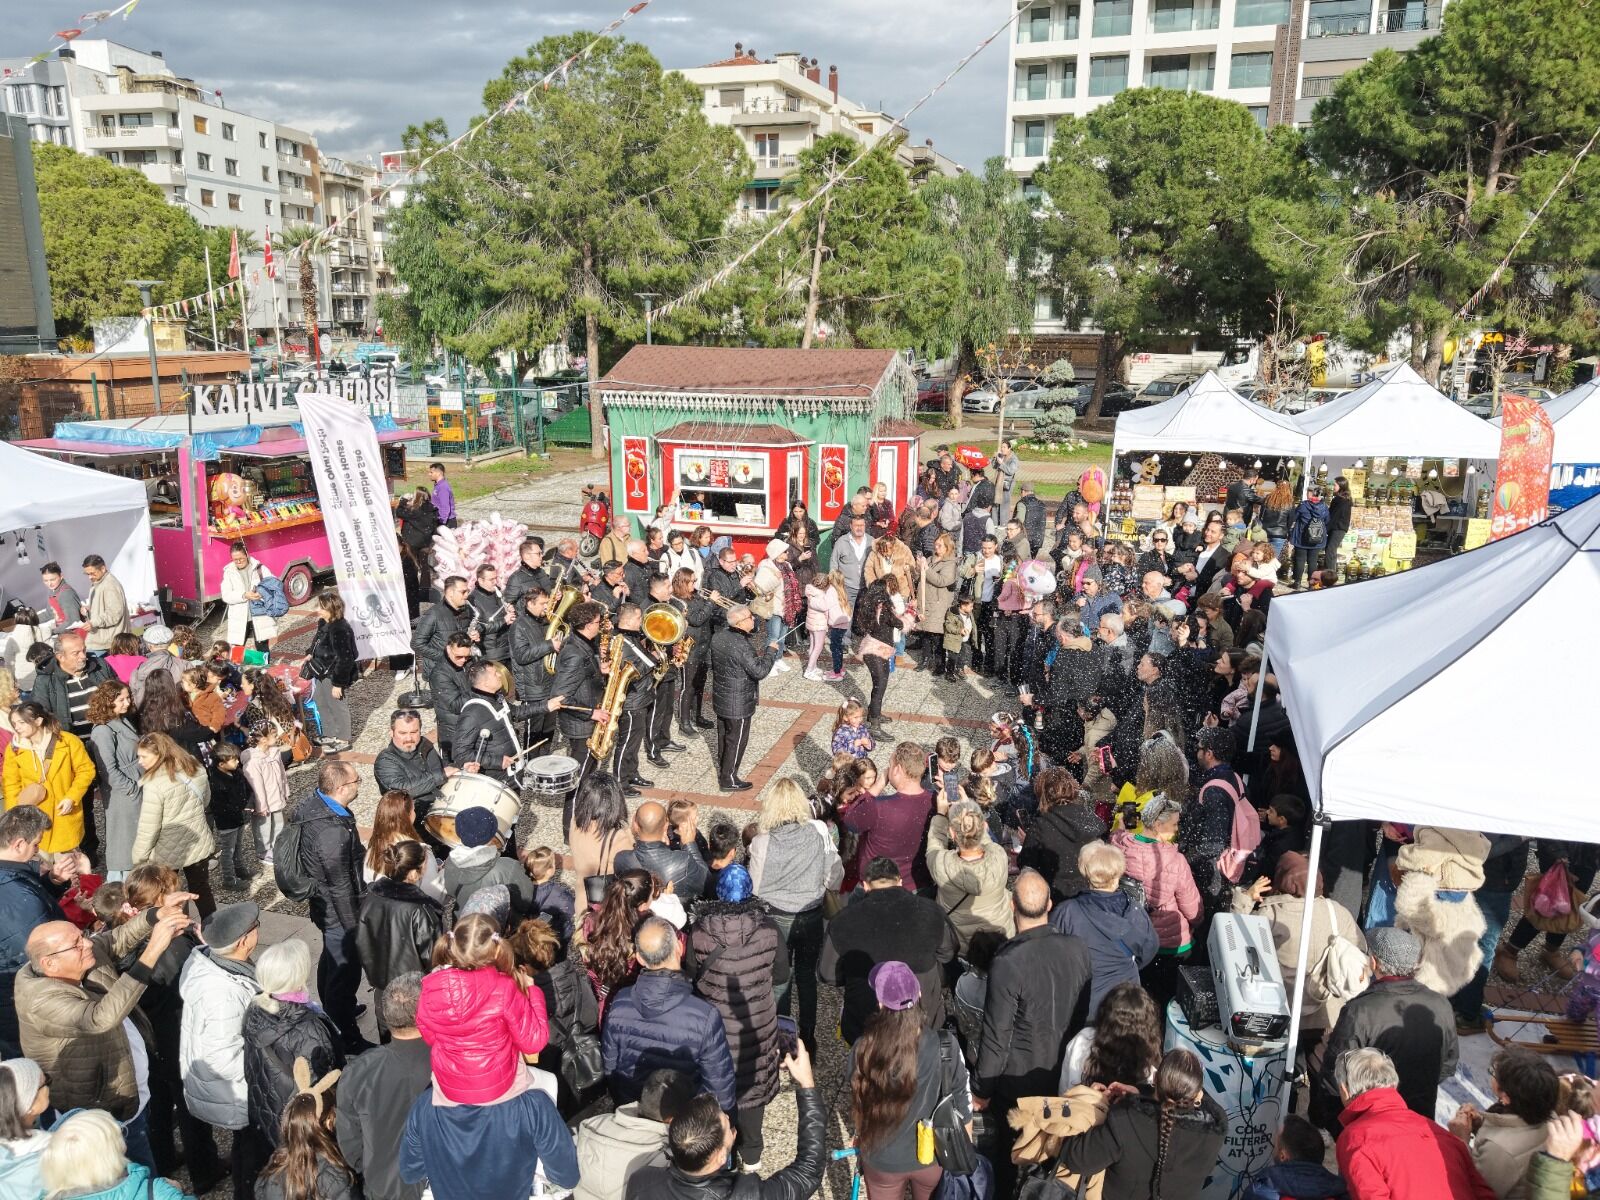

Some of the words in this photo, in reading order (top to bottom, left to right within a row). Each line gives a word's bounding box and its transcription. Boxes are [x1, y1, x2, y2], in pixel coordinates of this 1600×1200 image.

[193, 383, 292, 416] KAHVE
[1235, 1123, 1267, 1135] COLD
[1223, 1132, 1272, 1147] FILTERED
